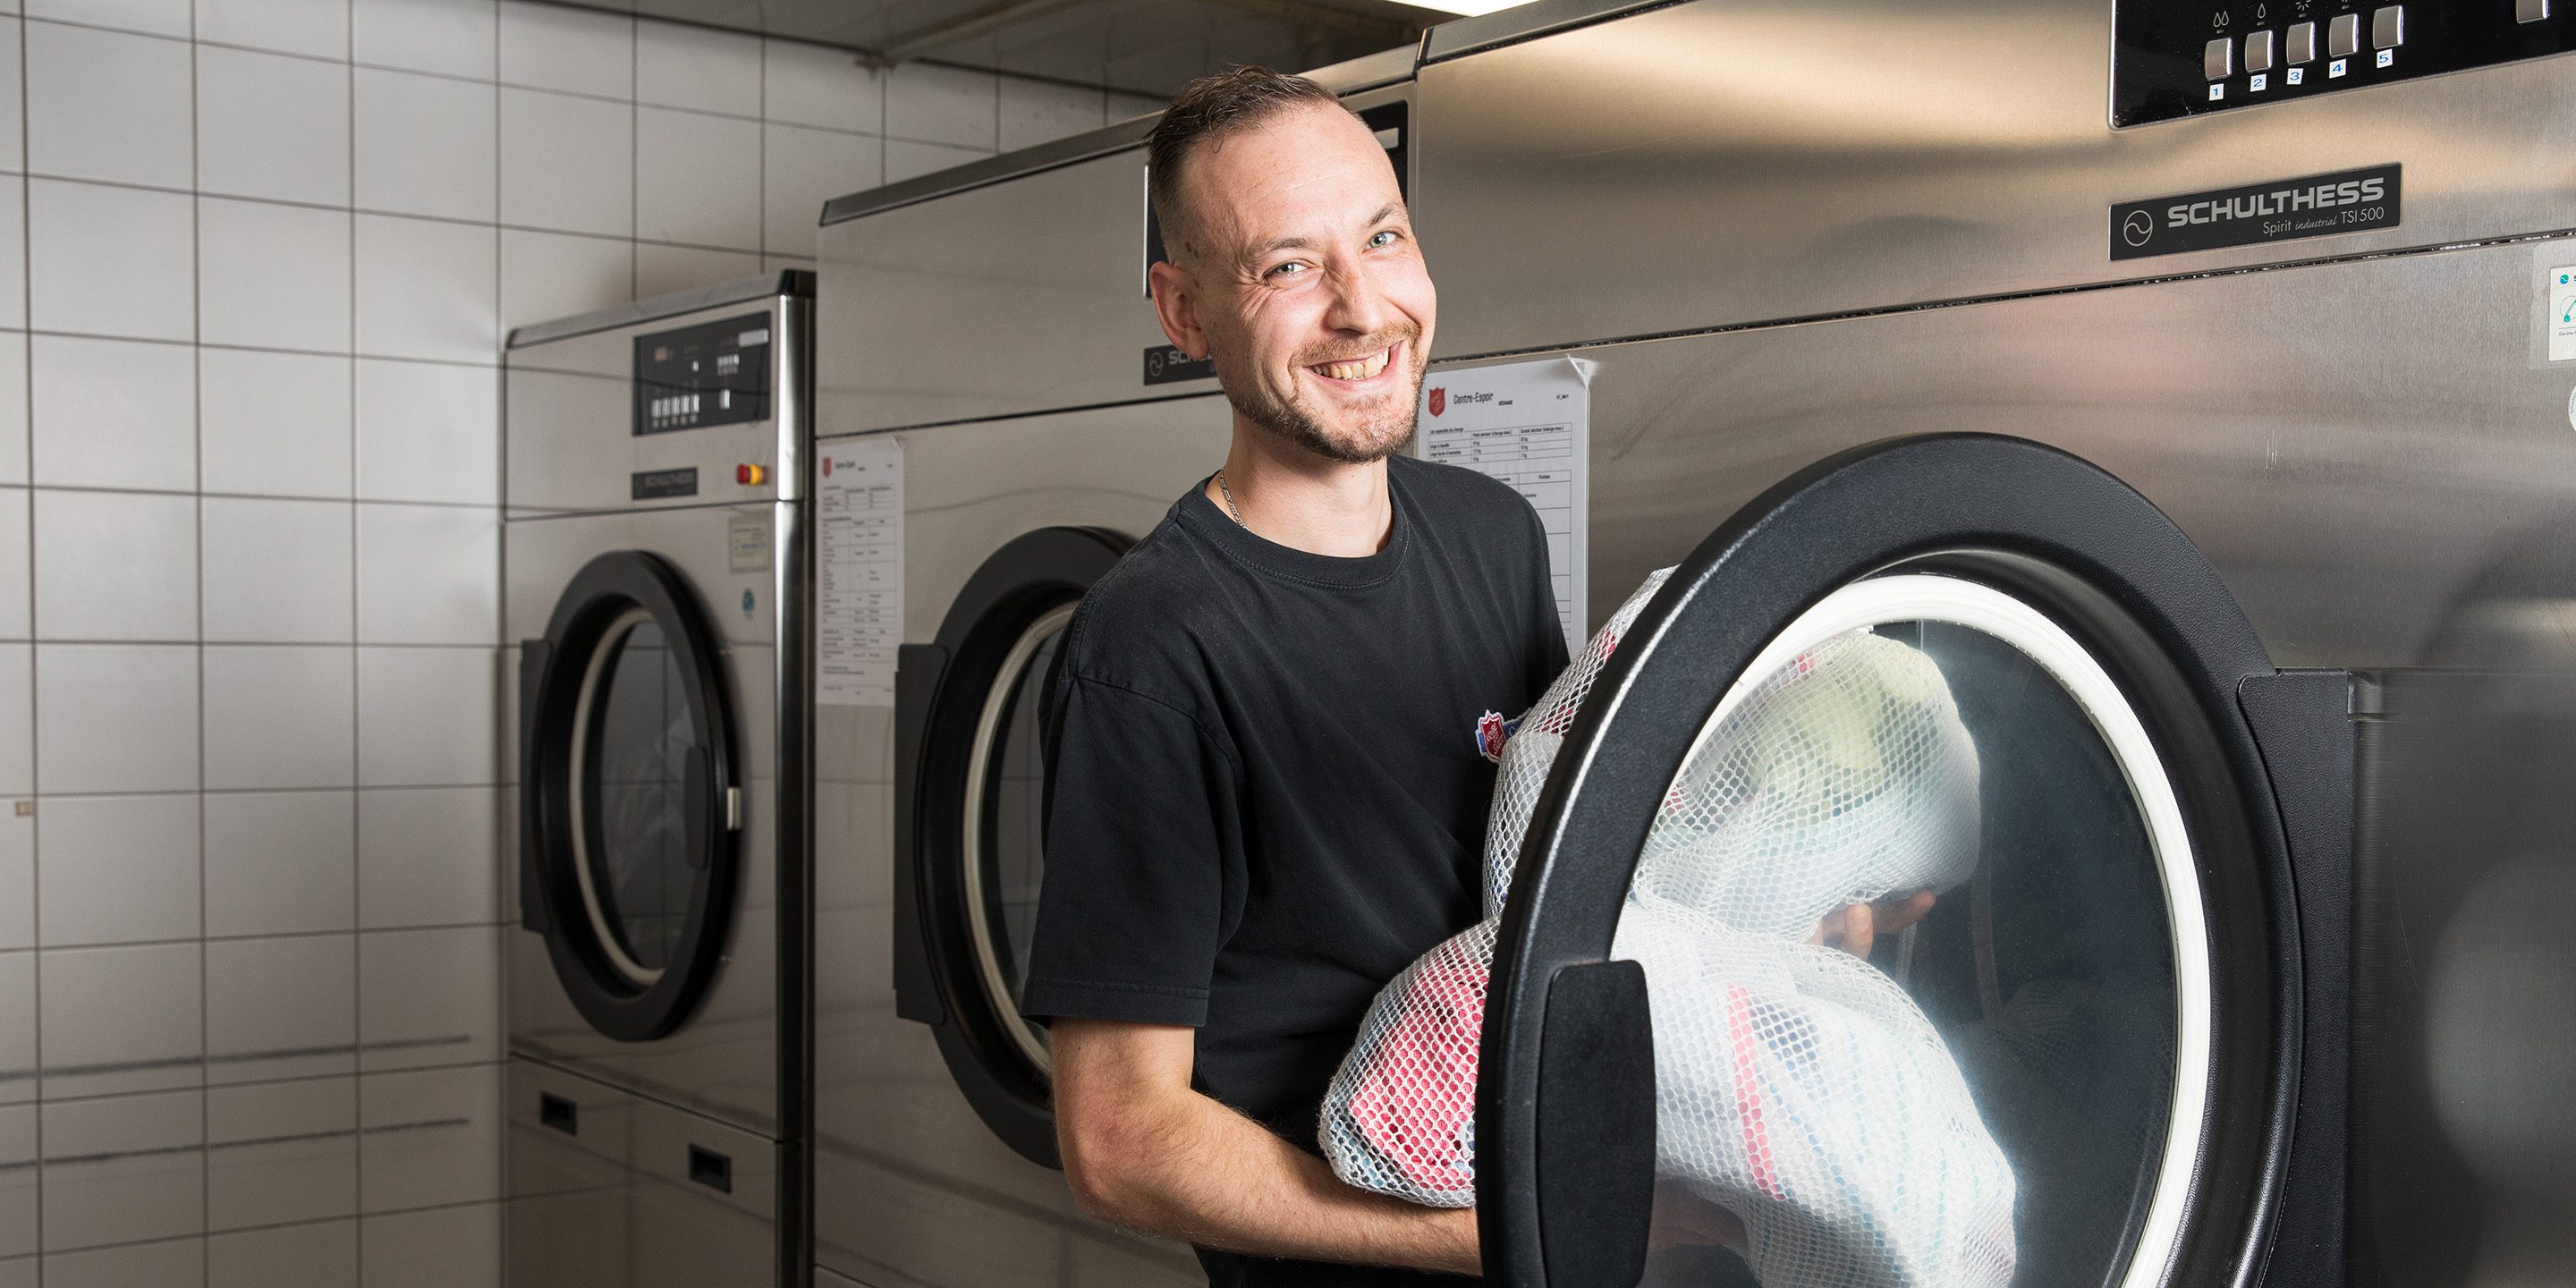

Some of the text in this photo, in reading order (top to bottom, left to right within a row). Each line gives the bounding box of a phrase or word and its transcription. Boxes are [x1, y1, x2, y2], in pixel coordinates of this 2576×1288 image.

[2253, 79, 2263, 87] 2
[2290, 72, 2300, 80] 3
[2332, 64, 2343, 72] 4
[2378, 55, 2389, 63] 5
[2167, 177, 2385, 228] SCHULTHESS
[2263, 207, 2385, 237] Spirit industrial TSI 500
[1453, 392, 1494, 404] Centre-Espoir
